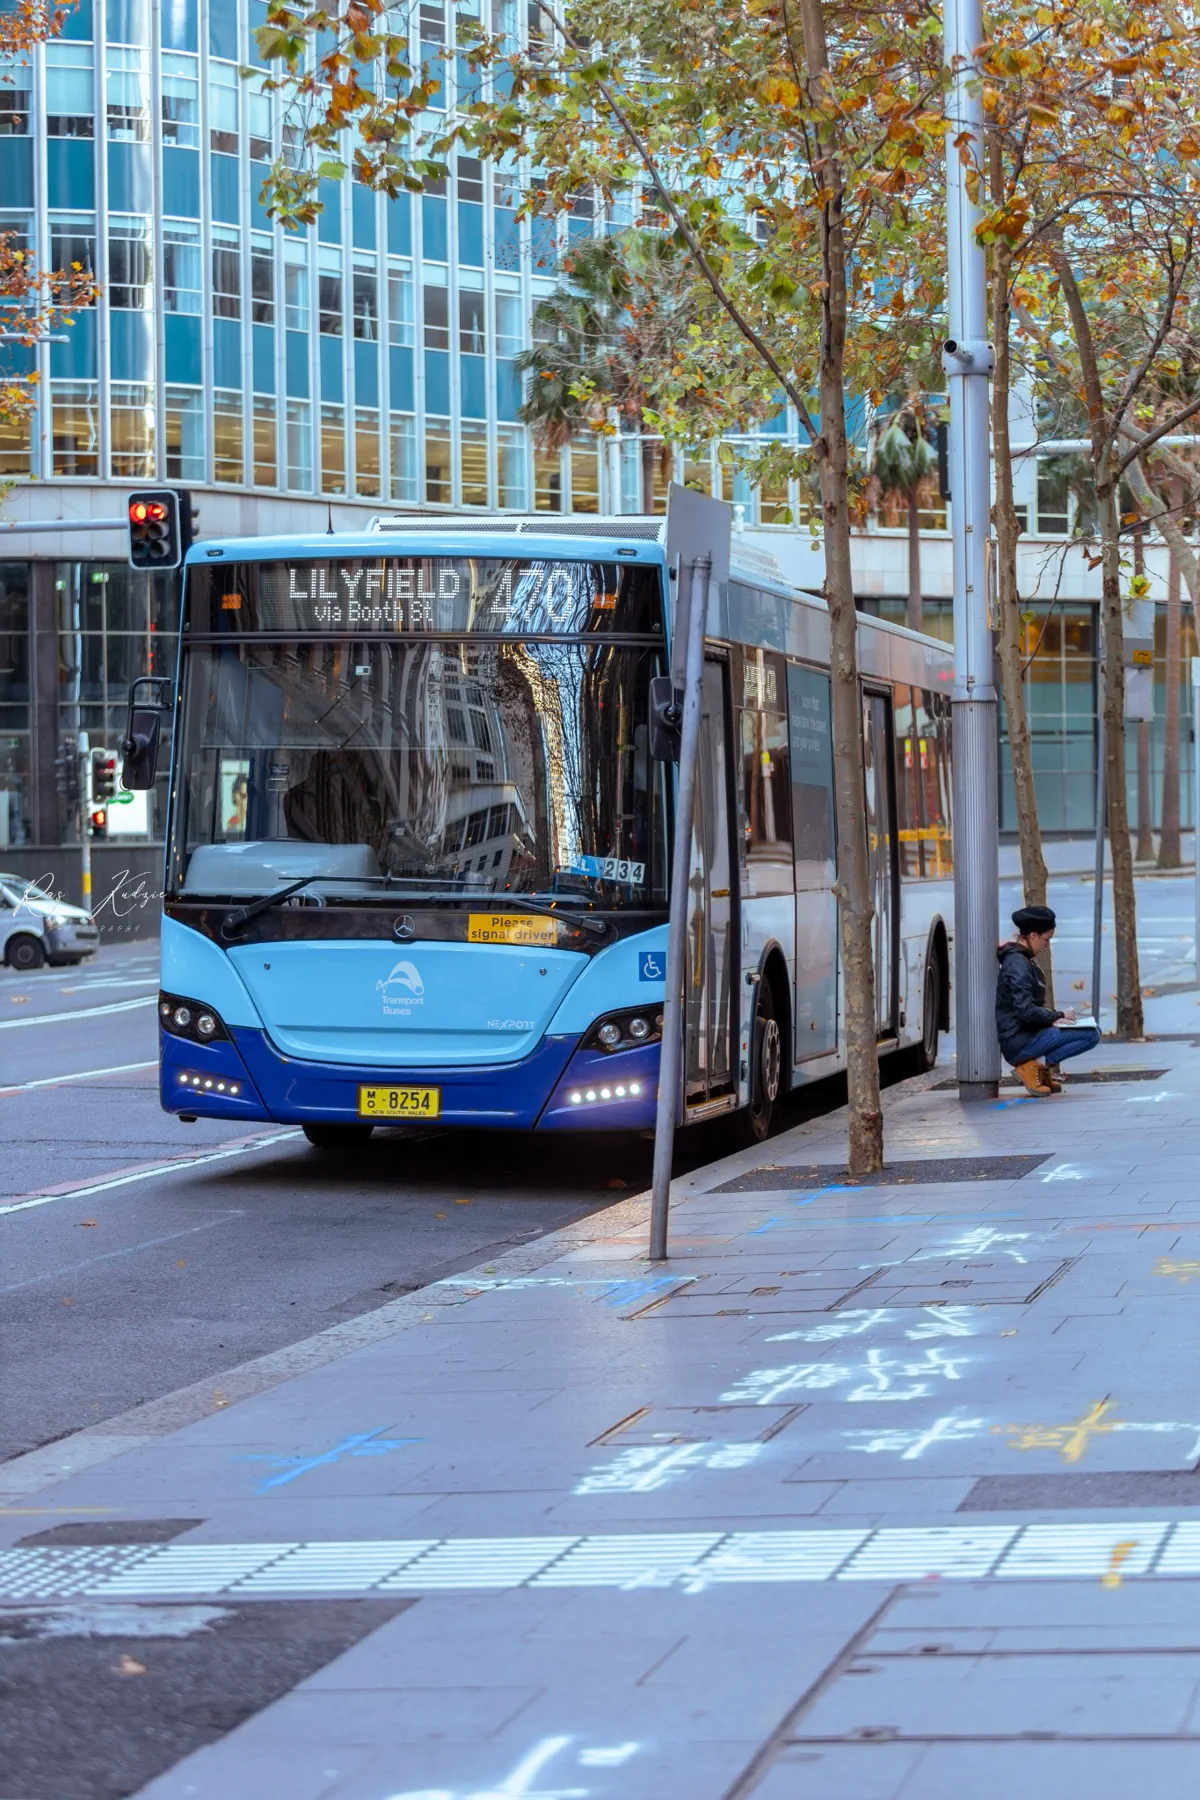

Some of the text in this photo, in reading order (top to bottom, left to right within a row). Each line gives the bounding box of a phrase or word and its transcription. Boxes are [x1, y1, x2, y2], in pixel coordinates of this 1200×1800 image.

[290, 569, 461, 599] LILYFIELD
[490, 569, 574, 622] 470
[314, 601, 433, 621] via Booth St
[491, 917, 534, 928] Please
[471, 928, 554, 940] signal driver
[381, 996, 425, 1006] Transport
[383, 1006, 412, 1016] Buses
[487, 1020, 536, 1029] NEXPORT
